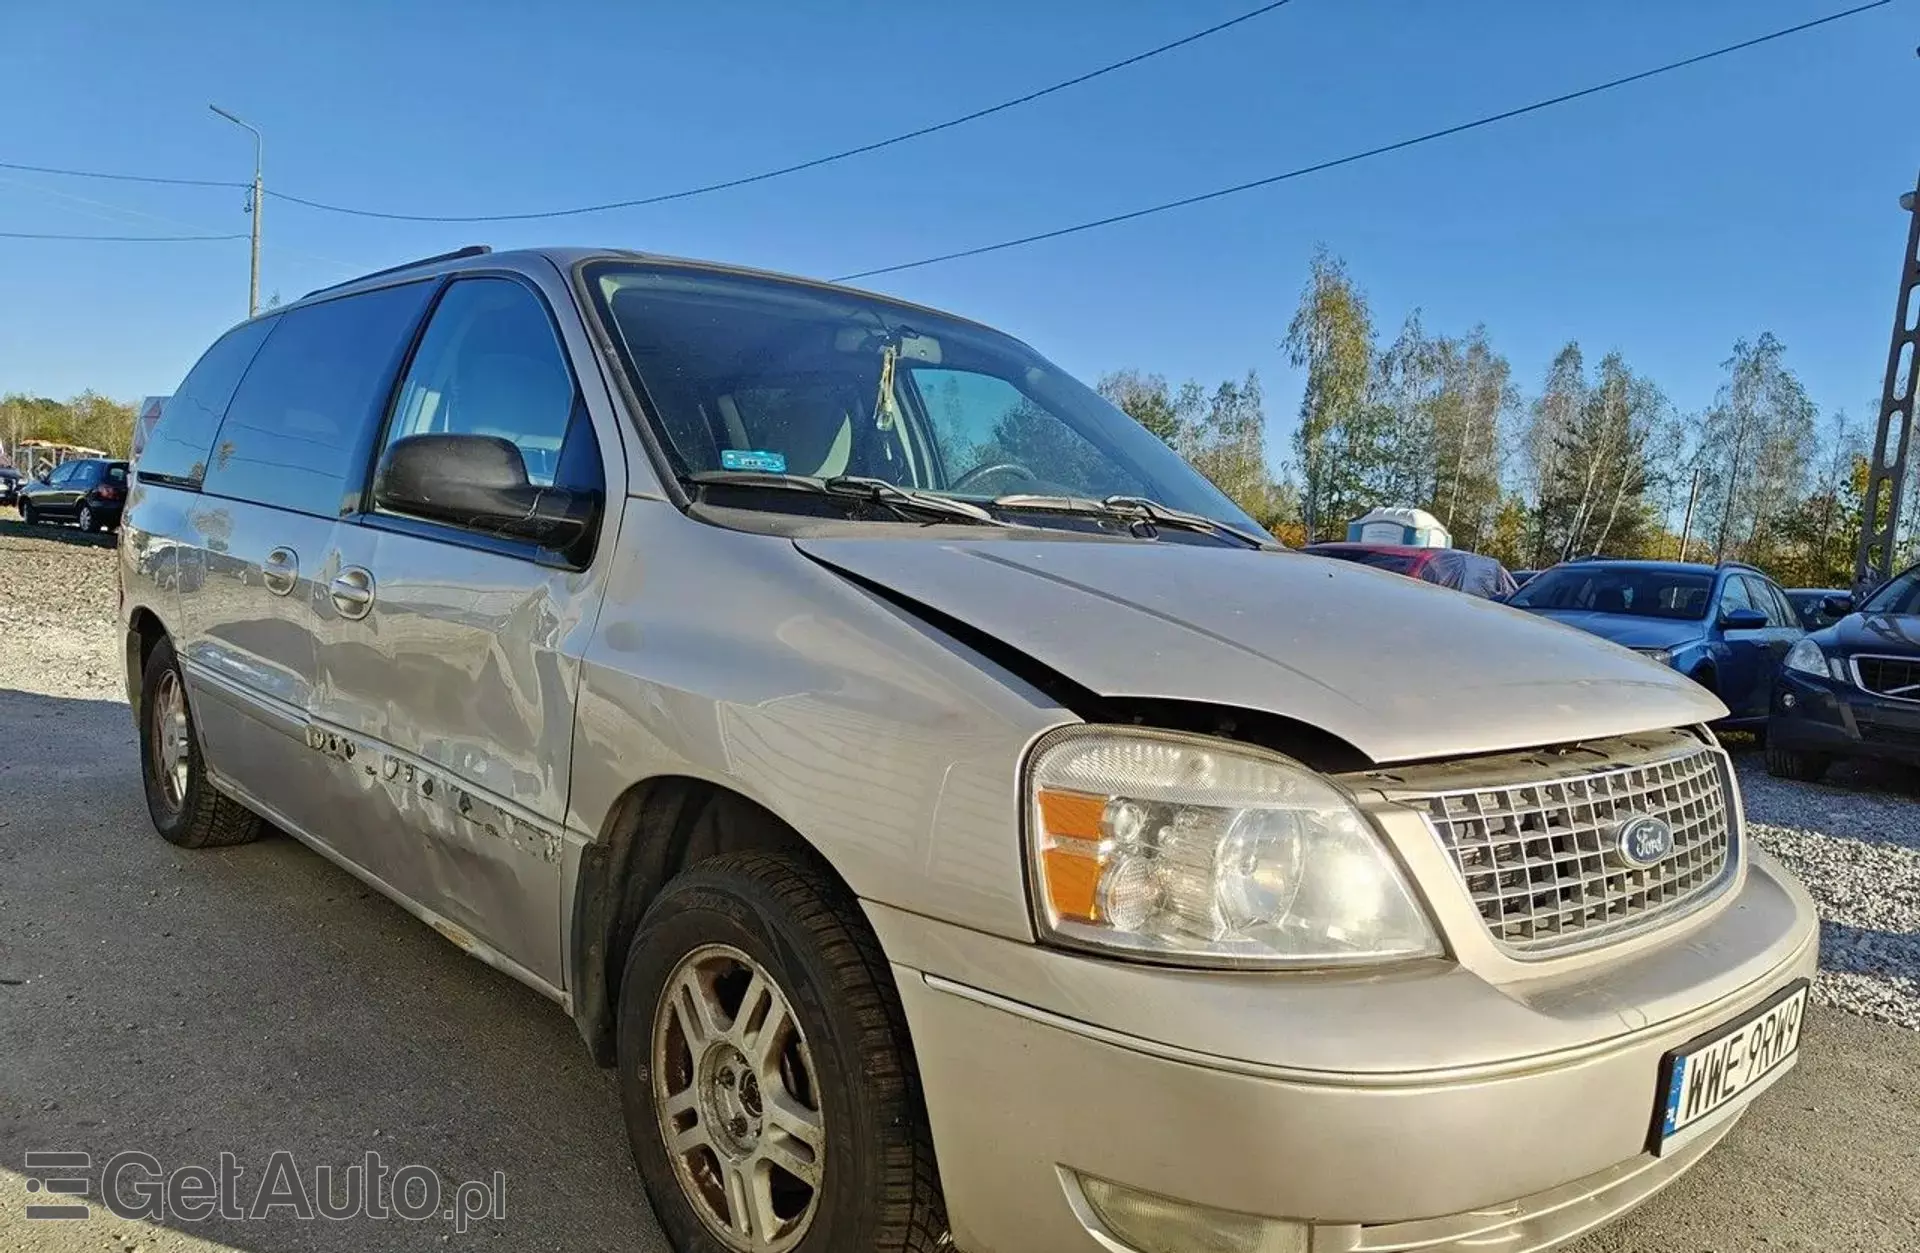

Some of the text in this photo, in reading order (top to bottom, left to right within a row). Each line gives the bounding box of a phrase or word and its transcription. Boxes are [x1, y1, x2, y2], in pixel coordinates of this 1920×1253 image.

[1636, 825, 1664, 858] Ford
[1684, 997, 1800, 1120] WWE 9RW9
